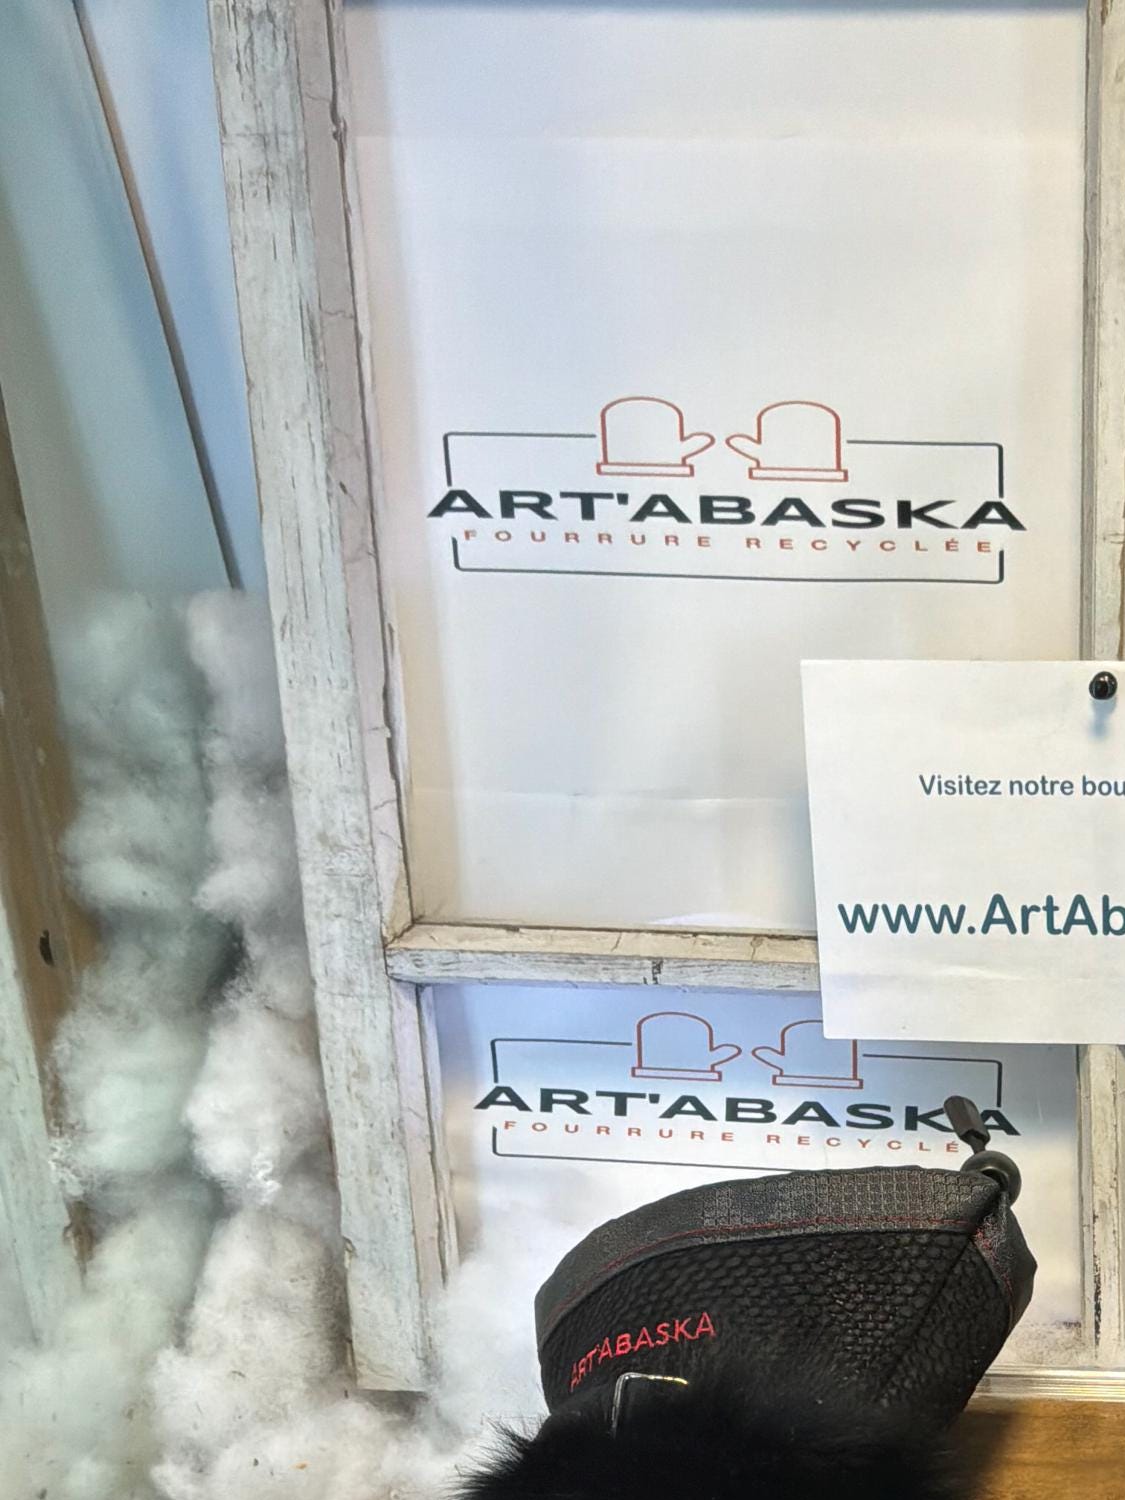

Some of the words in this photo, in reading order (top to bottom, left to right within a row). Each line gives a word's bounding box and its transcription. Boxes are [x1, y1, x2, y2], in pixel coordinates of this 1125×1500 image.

[428, 489, 1026, 531] ART'ABASKA
[463, 529, 711, 548] FOURRURE
[745, 537, 992, 554] RECYCLÉE
[919, 774, 1002, 796] Visitez
[1009, 775, 1074, 797] notre
[504, 1121, 734, 1142] FOURRURE
[766, 1134, 959, 1153] RECYCLÉ
